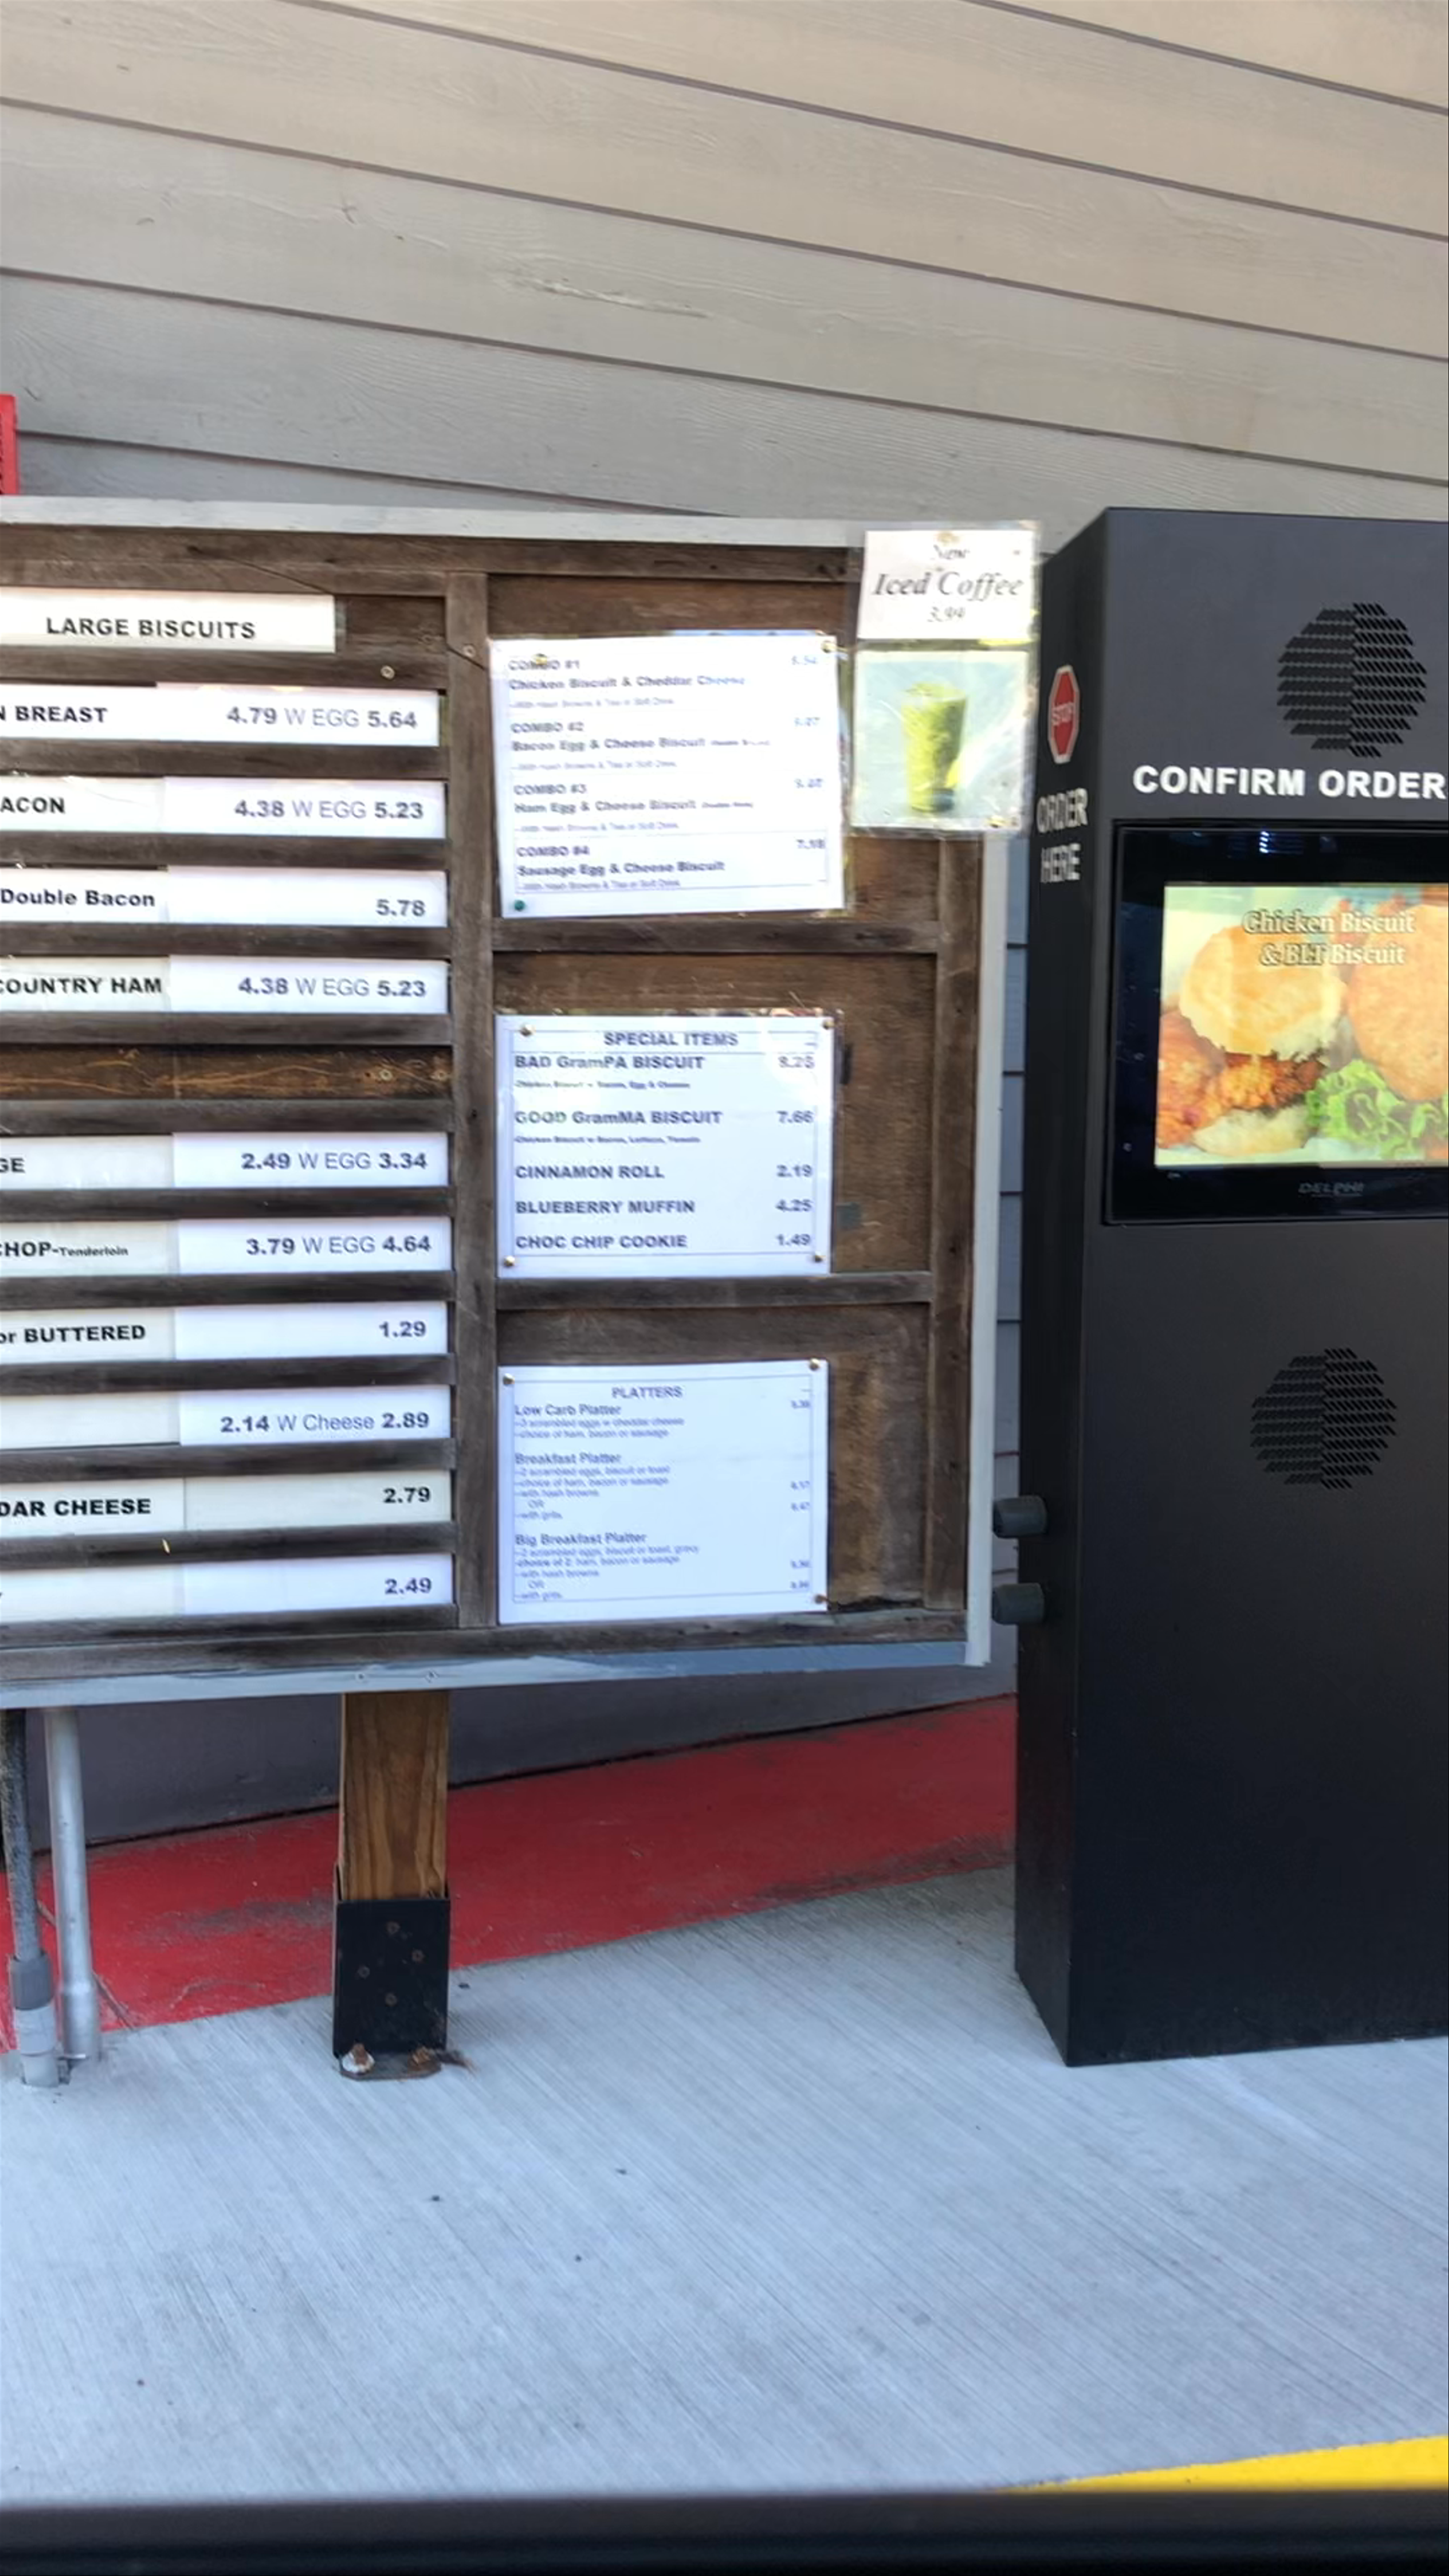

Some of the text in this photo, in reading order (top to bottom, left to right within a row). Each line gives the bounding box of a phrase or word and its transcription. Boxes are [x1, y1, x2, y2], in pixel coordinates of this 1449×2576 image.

[872, 570, 1024, 601] Iced Coffee
[45, 617, 257, 640] LARGE BISCUITS
[509, 678, 565, 690] Chicken
[569, 677, 617, 689] Biscuit
[621, 676, 632, 687] &
[637, 676, 692, 687] Cheddar
[15, 705, 109, 724] BREAST
[226, 707, 418, 729] 4.79 W EGG 5.64
[511, 722, 563, 733] COMBO
[511, 741, 555, 752] Bacon
[560, 740, 586, 753] Egg
[590, 739, 600, 750] &
[604, 738, 655, 749] Cheese
[658, 737, 706, 748] Biscuit
[514, 783, 566, 795] COMBO
[1133, 764, 1447, 799] CONFIRM ORDER
[235, 800, 424, 820] 4.38 W EGG 5.23
[515, 802, 547, 814] Ham
[551, 802, 577, 814] Egg
[595, 800, 646, 811] Cheese
[649, 799, 696, 810] Biscuit
[1037, 788, 1088, 833] ORDER
[517, 846, 569, 857] COMBO
[517, 861, 725, 877] Sausage Egg & Cheese Biscuit
[1040, 842, 1081, 884] HERE
[0, 888, 156, 908] Double Bacon
[377, 899, 426, 917] 5.78
[1243, 909, 1416, 936] Chicken Biscuit
[1259, 944, 1406, 966] & BLT Biscuit
[0, 977, 162, 995] OUNTRY HAM
[238, 977, 427, 998] 4.38 W EGG 5.23
[604, 1032, 738, 1046] SPECIAL ITEMS
[514, 1056, 705, 1069] BAD GramPA BISCUIT
[514, 1111, 723, 1124] GOOD GramMA BISCUIT
[241, 1153, 428, 1170] 2.49 W EGG 3.34
[515, 1166, 665, 1179] CINNAMON ROLL
[776, 1165, 812, 1178] 2.19
[516, 1201, 695, 1215] BLUEBERRY MUFFIN
[775, 1200, 812, 1212] 4.25
[246, 1236, 432, 1256] 3.79 W EGG 4.64
[516, 1235, 687, 1249] CHOC CHIP COOKIE
[776, 1233, 811, 1247] 1.49
[25, 1324, 146, 1344] BUTTERED
[378, 1321, 427, 1339] 1.29
[611, 1387, 683, 1399] PLATTERS
[515, 1403, 621, 1416] Low Carb Platter
[220, 1412, 429, 1433] 2.14 W Cheese 2.89
[515, 1452, 622, 1464] Breakfast Platter
[383, 1487, 431, 1504] 2.79
[0, 1498, 151, 1517] DAR CHEESE
[515, 1531, 648, 1546] Big Breakfast Platter
[385, 1577, 433, 1595] 2.49
